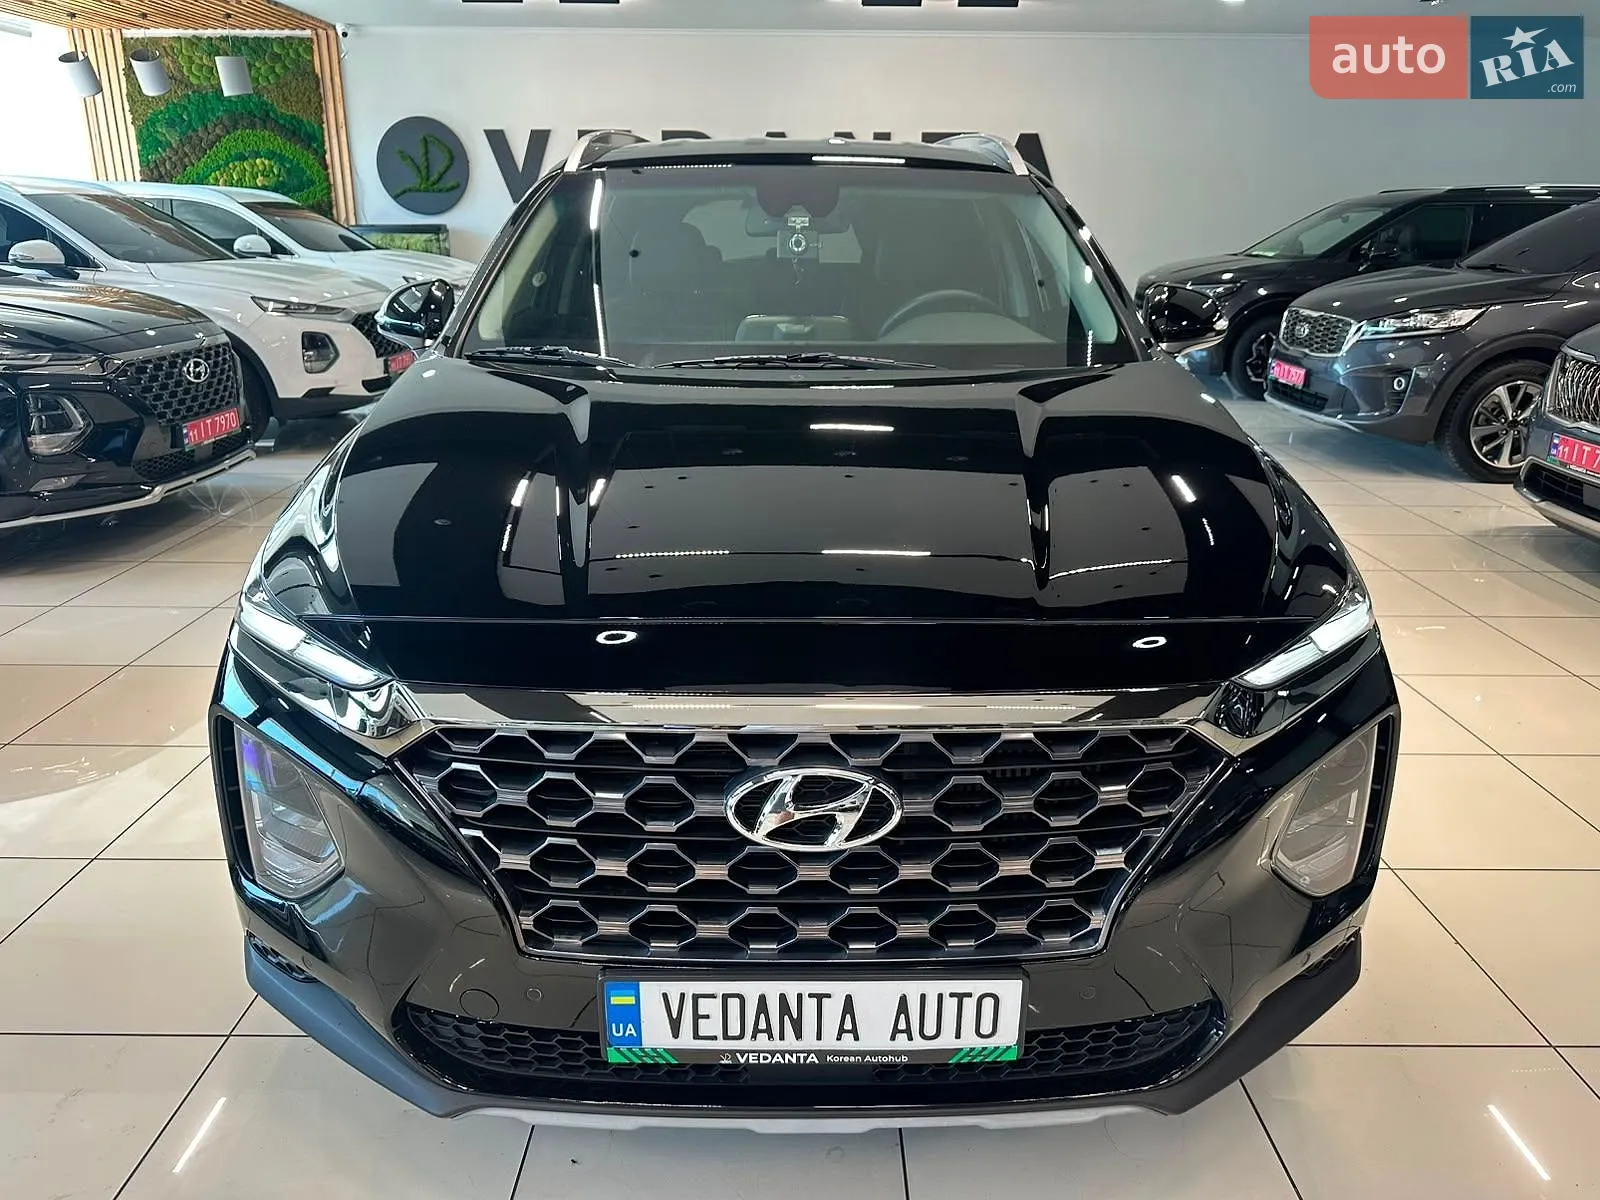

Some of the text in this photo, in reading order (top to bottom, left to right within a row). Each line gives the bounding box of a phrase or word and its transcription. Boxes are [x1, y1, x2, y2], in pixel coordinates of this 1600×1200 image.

[214, 411, 237, 434] 7970
[661, 991, 1000, 1041] VEDANTA AUTO
[611, 1023, 637, 1037] UA
[735, 1052, 909, 1064] VEDANTA Korean Autohub
